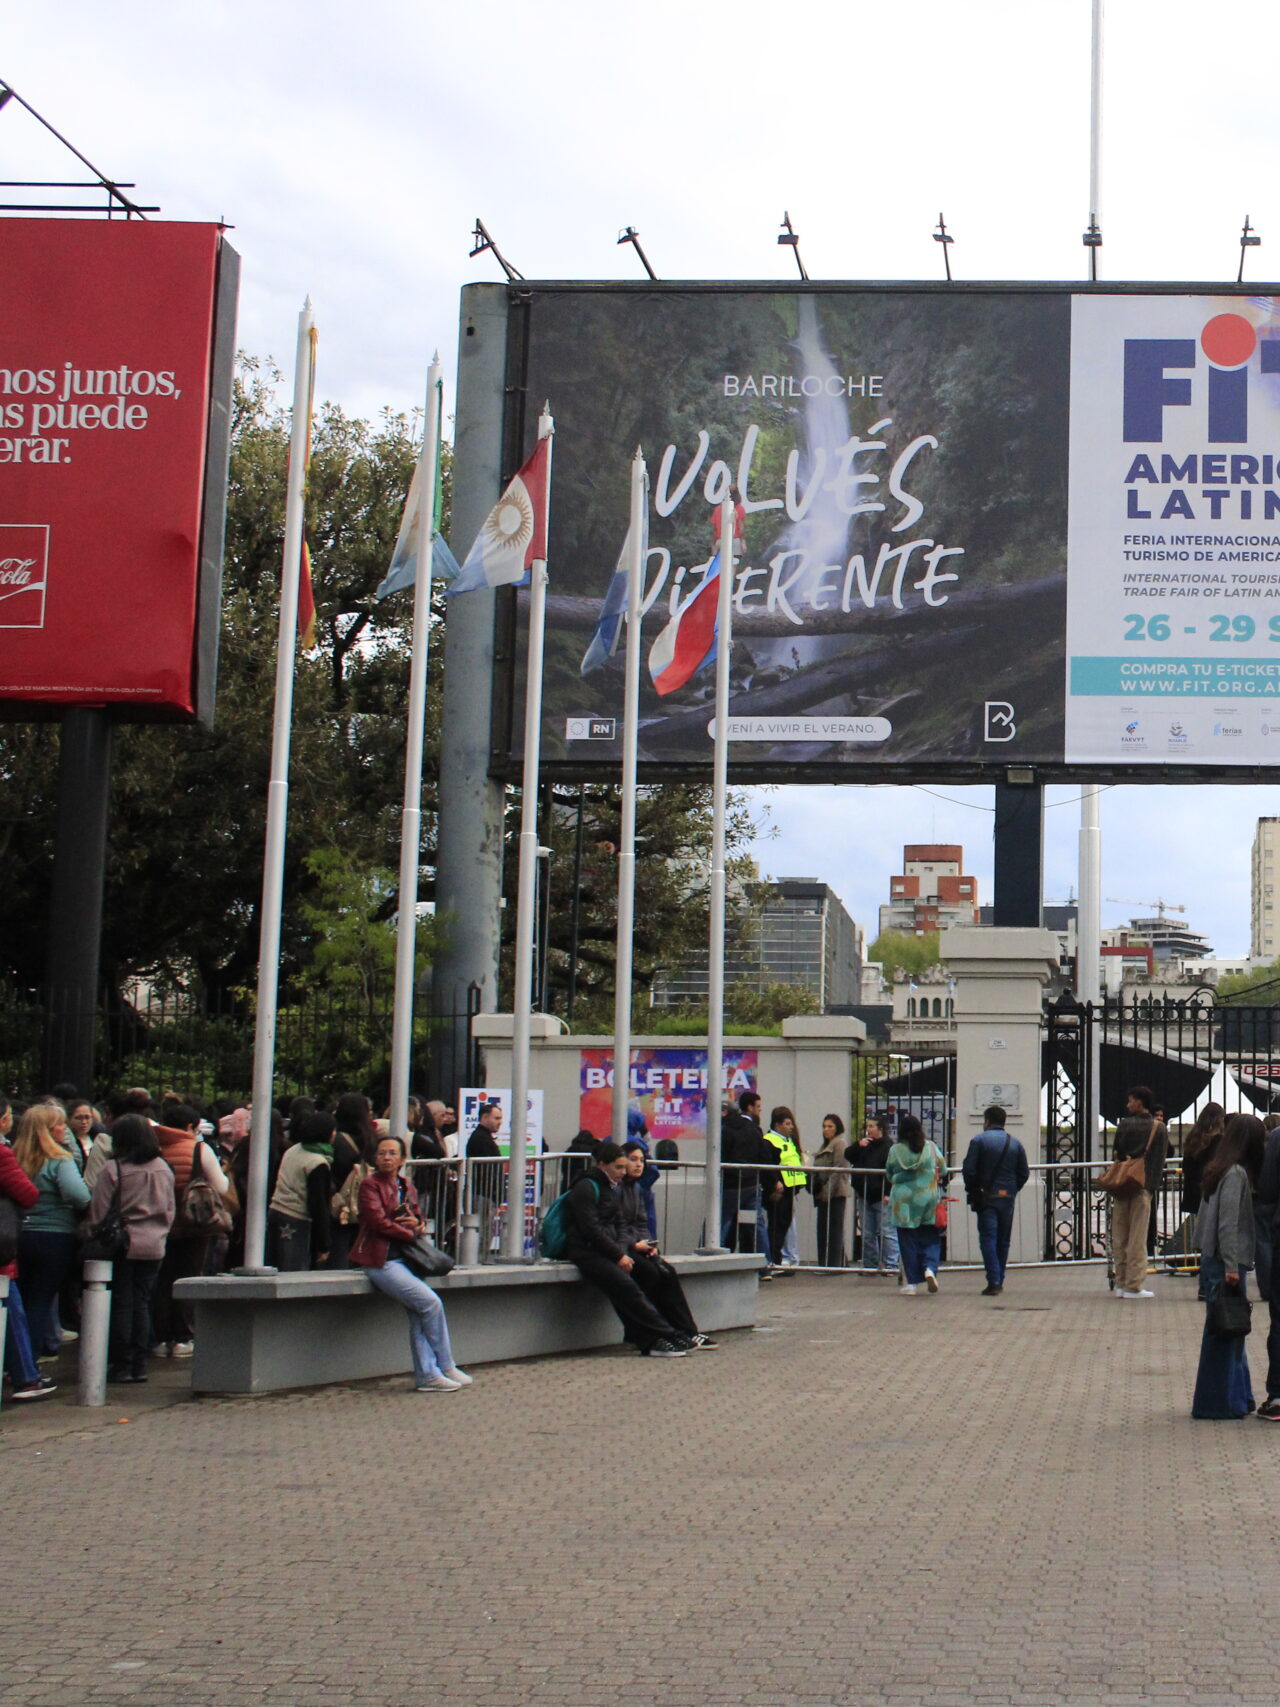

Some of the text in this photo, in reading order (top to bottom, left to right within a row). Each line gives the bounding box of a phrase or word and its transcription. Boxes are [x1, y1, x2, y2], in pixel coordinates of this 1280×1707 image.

[58, 362, 182, 402] juntos,
[724, 375, 883, 397] BARILOCHE
[30, 396, 148, 436] puede
[1123, 535, 1166, 546] FERIA
[1123, 550, 1190, 561] TURISMO
[1194, 551, 1214, 562] DE
[1123, 574, 1227, 583] INTERNATIONAL
[1123, 588, 1166, 597] TRADE
[1170, 588, 1199, 597] FAIR
[1203, 588, 1221, 598] OF
[1224, 588, 1261, 598] LATIN
[1123, 613, 1171, 641] 26
[1184, 626, 1196, 634] -
[1208, 614, 1256, 642] 29
[1120, 663, 1188, 675] COMPRA
[1192, 664, 1212, 676] TU
[592, 724, 610, 734] RN
[756, 724, 764, 732] A
[767, 724, 800, 733] VIVIR
[804, 724, 818, 733] EL
[822, 724, 876, 733] VERANO.
